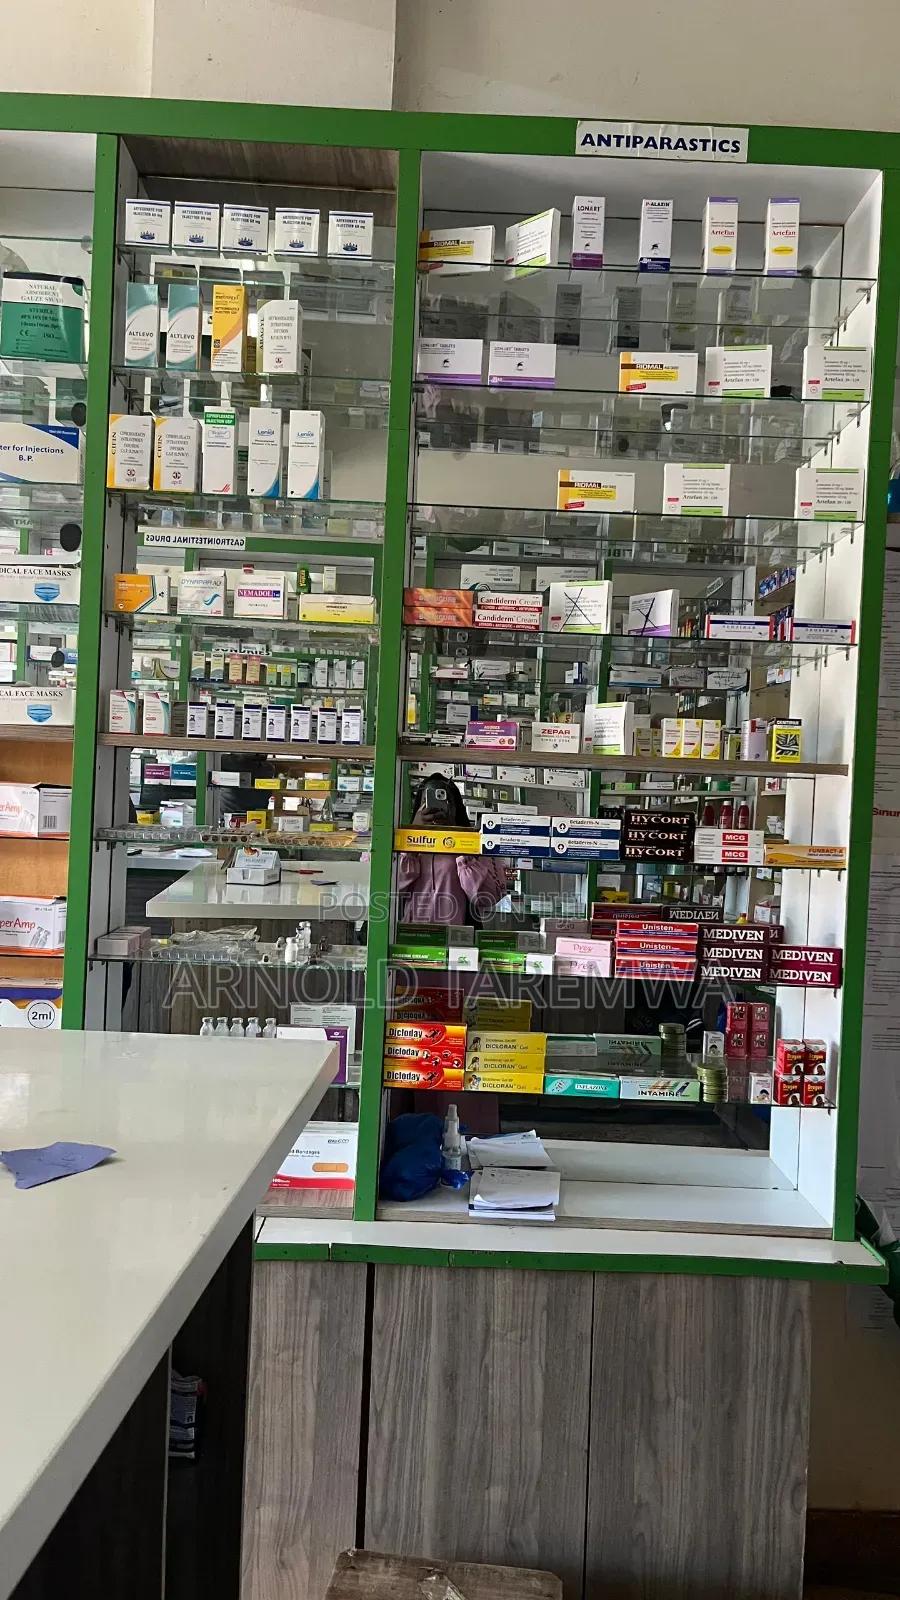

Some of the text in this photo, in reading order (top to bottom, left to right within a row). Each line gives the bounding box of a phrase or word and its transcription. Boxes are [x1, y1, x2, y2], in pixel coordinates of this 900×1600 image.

[581, 133, 741, 153] ANTIPARASTICS
[25, 445, 64, 454] Injections
[23, 568, 44, 576] FACE
[45, 569, 72, 577] MASKS
[481, 596, 517, 605] Candiderm
[478, 614, 538, 623] Candiderm Cream
[631, 815, 690, 824] HYCORT
[406, 835, 437, 844] Sulfur
[628, 831, 687, 840] HYCORT
[625, 847, 685, 857] HYCORT
[642, 923, 674, 931] Unisten
[703, 928, 765, 941] MEDIVEN
[639, 942, 671, 950] Unisten
[702, 947, 763, 960] MEDIVEN
[772, 949, 834, 962] MEDIVEN
[639, 961, 671, 969] Unisten
[700, 966, 762, 979] MEDIVEN
[769, 968, 832, 982] MEDIVEN
[31, 1011, 52, 1020] 2ml
[389, 1028, 423, 1038] Dicloday
[387, 1047, 420, 1057] Dicloday
[386, 1070, 421, 1081] Dicloday
